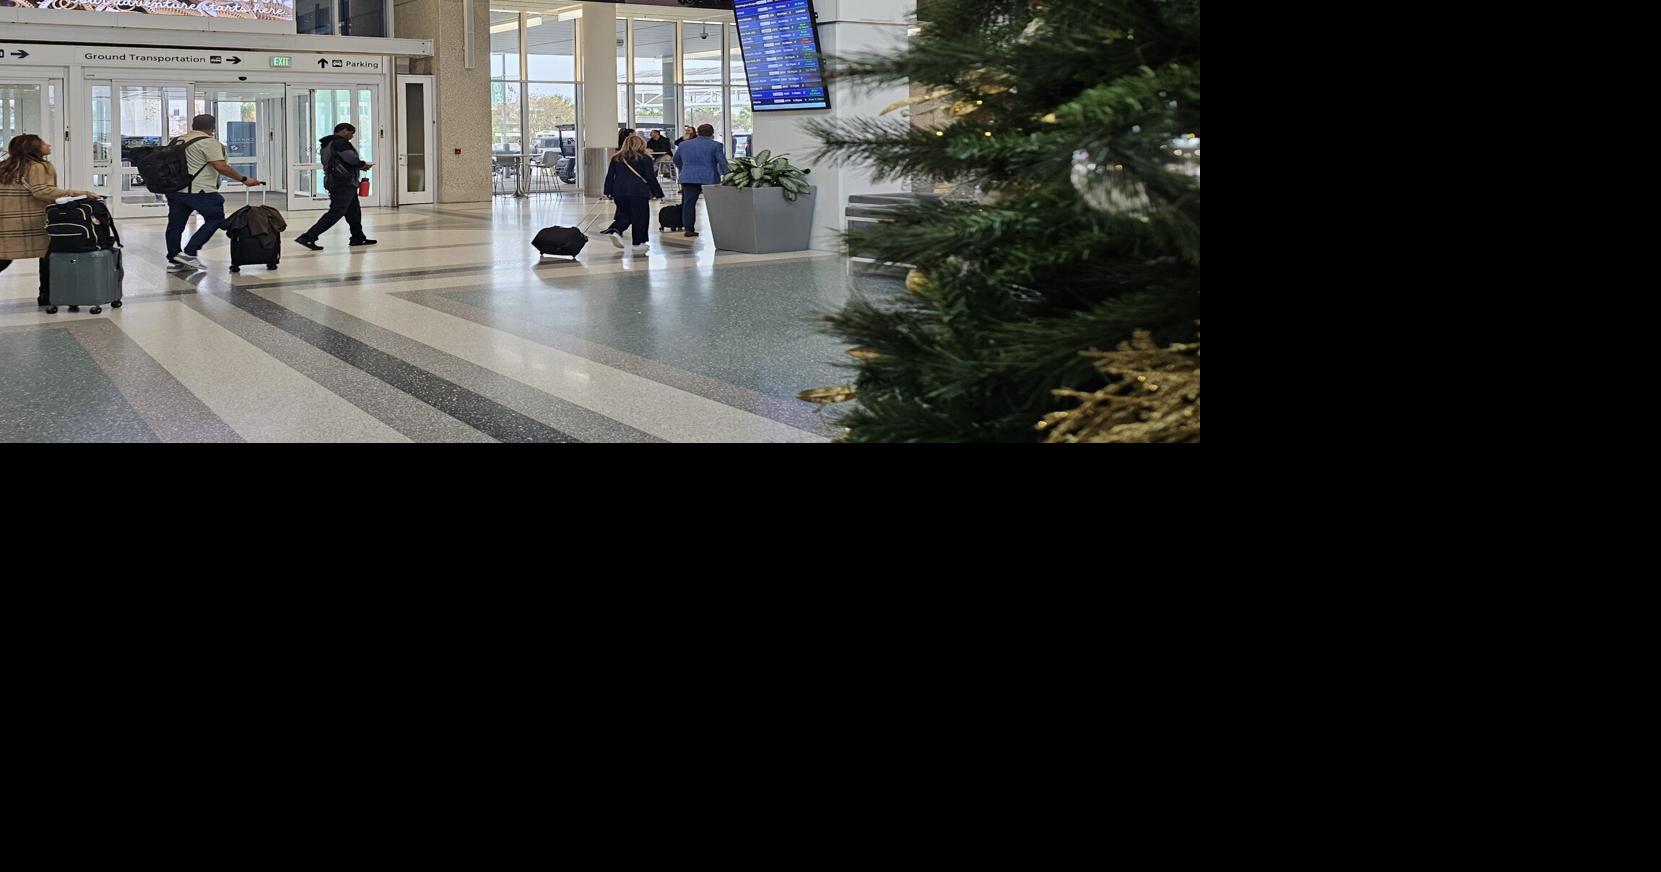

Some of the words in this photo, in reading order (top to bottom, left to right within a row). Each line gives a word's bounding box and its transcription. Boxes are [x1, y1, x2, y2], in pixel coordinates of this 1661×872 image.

[253, 3, 288, 15] here.
[84, 53, 126, 61] Ground
[129, 54, 206, 63] Transportation
[273, 57, 289, 66] EXIT
[346, 61, 379, 69] Parking
